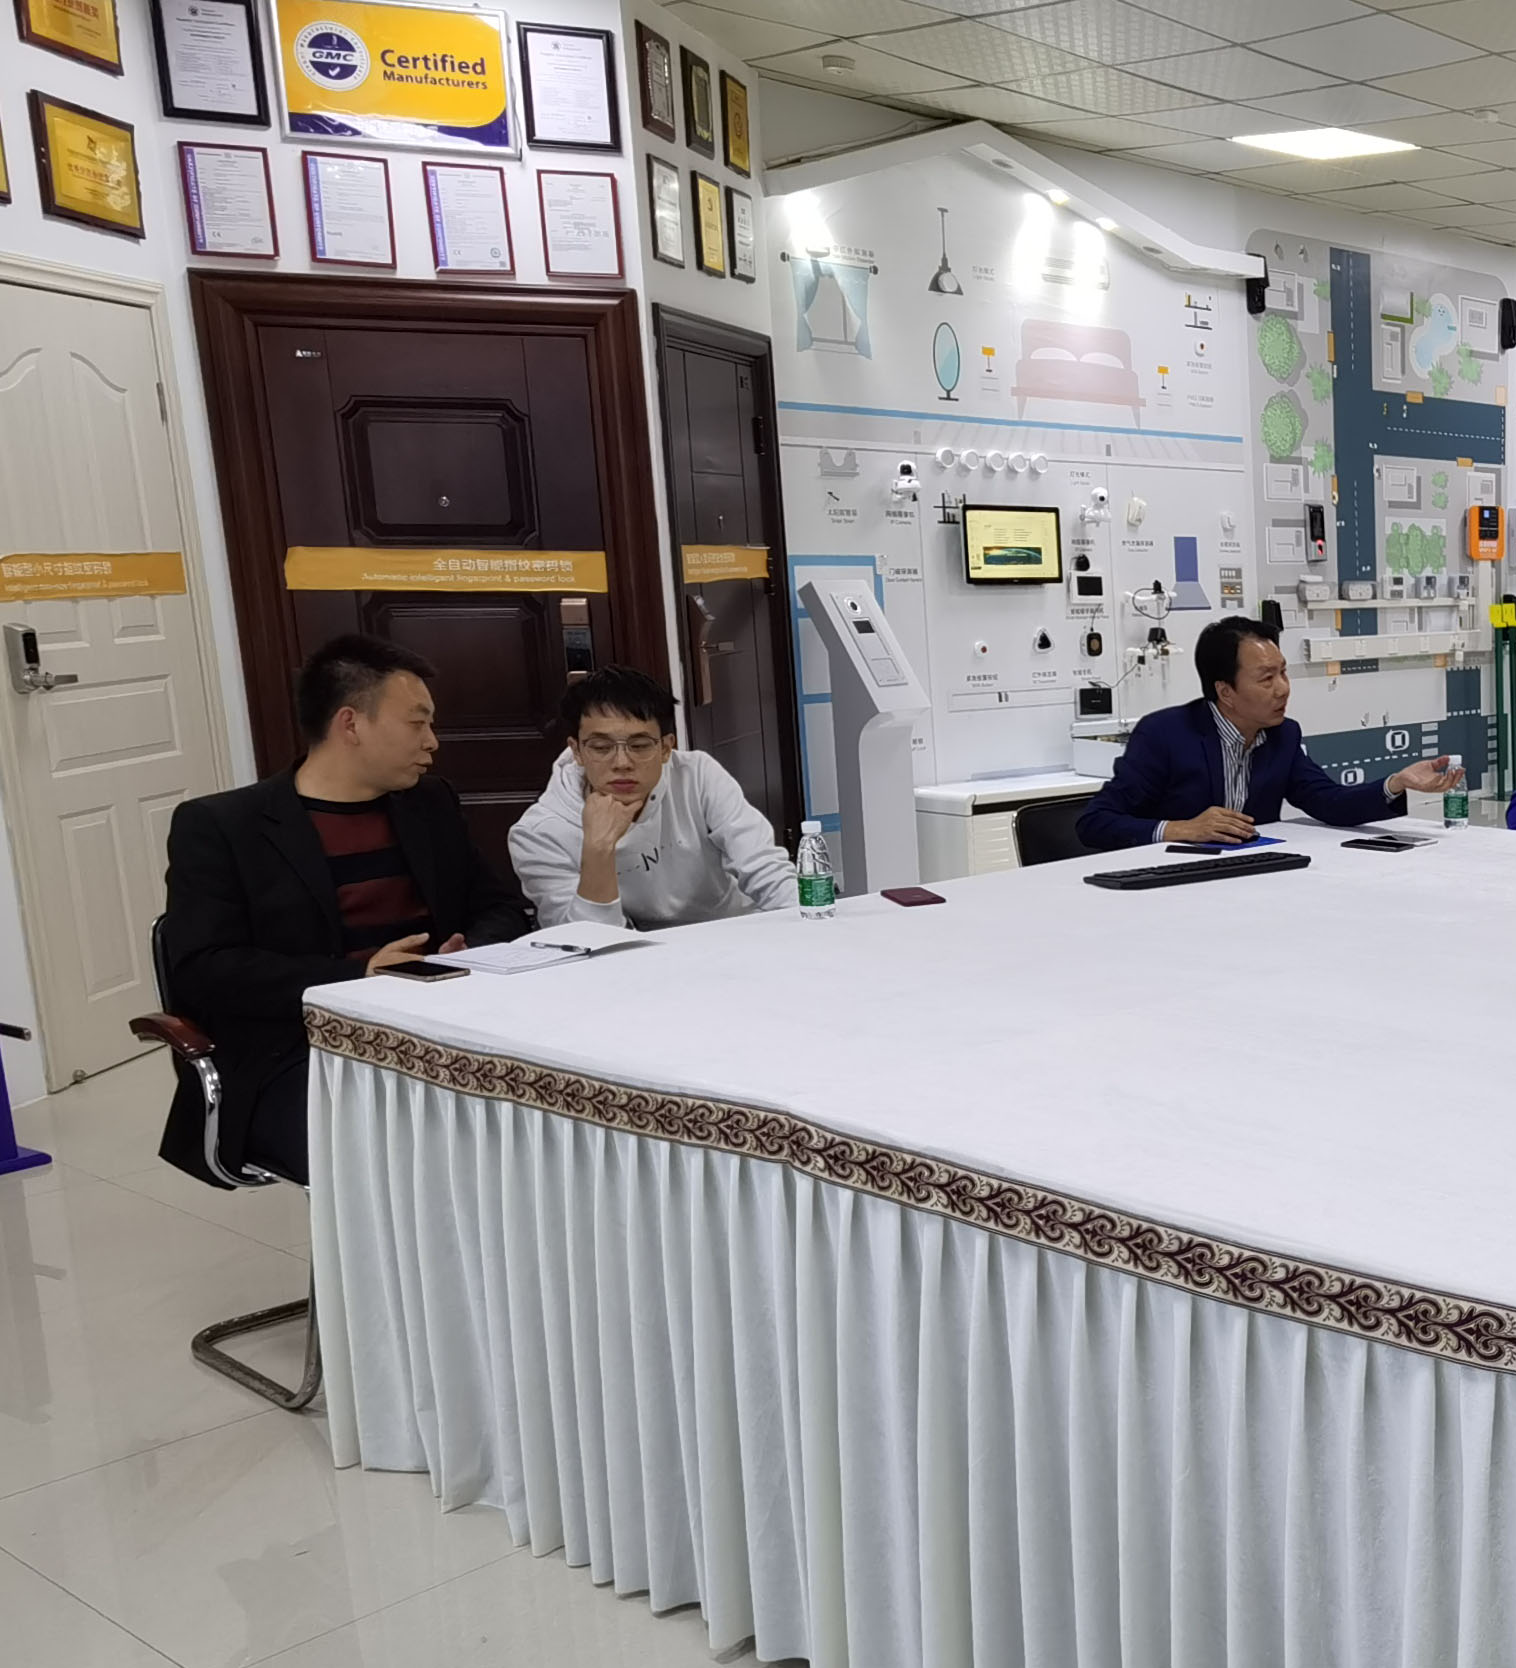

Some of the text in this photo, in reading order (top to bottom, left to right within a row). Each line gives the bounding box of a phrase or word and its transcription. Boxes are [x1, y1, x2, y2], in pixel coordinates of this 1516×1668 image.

[311, 49, 356, 62] GMC
[380, 49, 487, 76] Certified
[382, 70, 489, 90] Manufacturers
[432, 557, 574, 573] 全自动智能指纹密码锁
[361, 572, 575, 584] Automatic intelligent fingerprint & password lock
